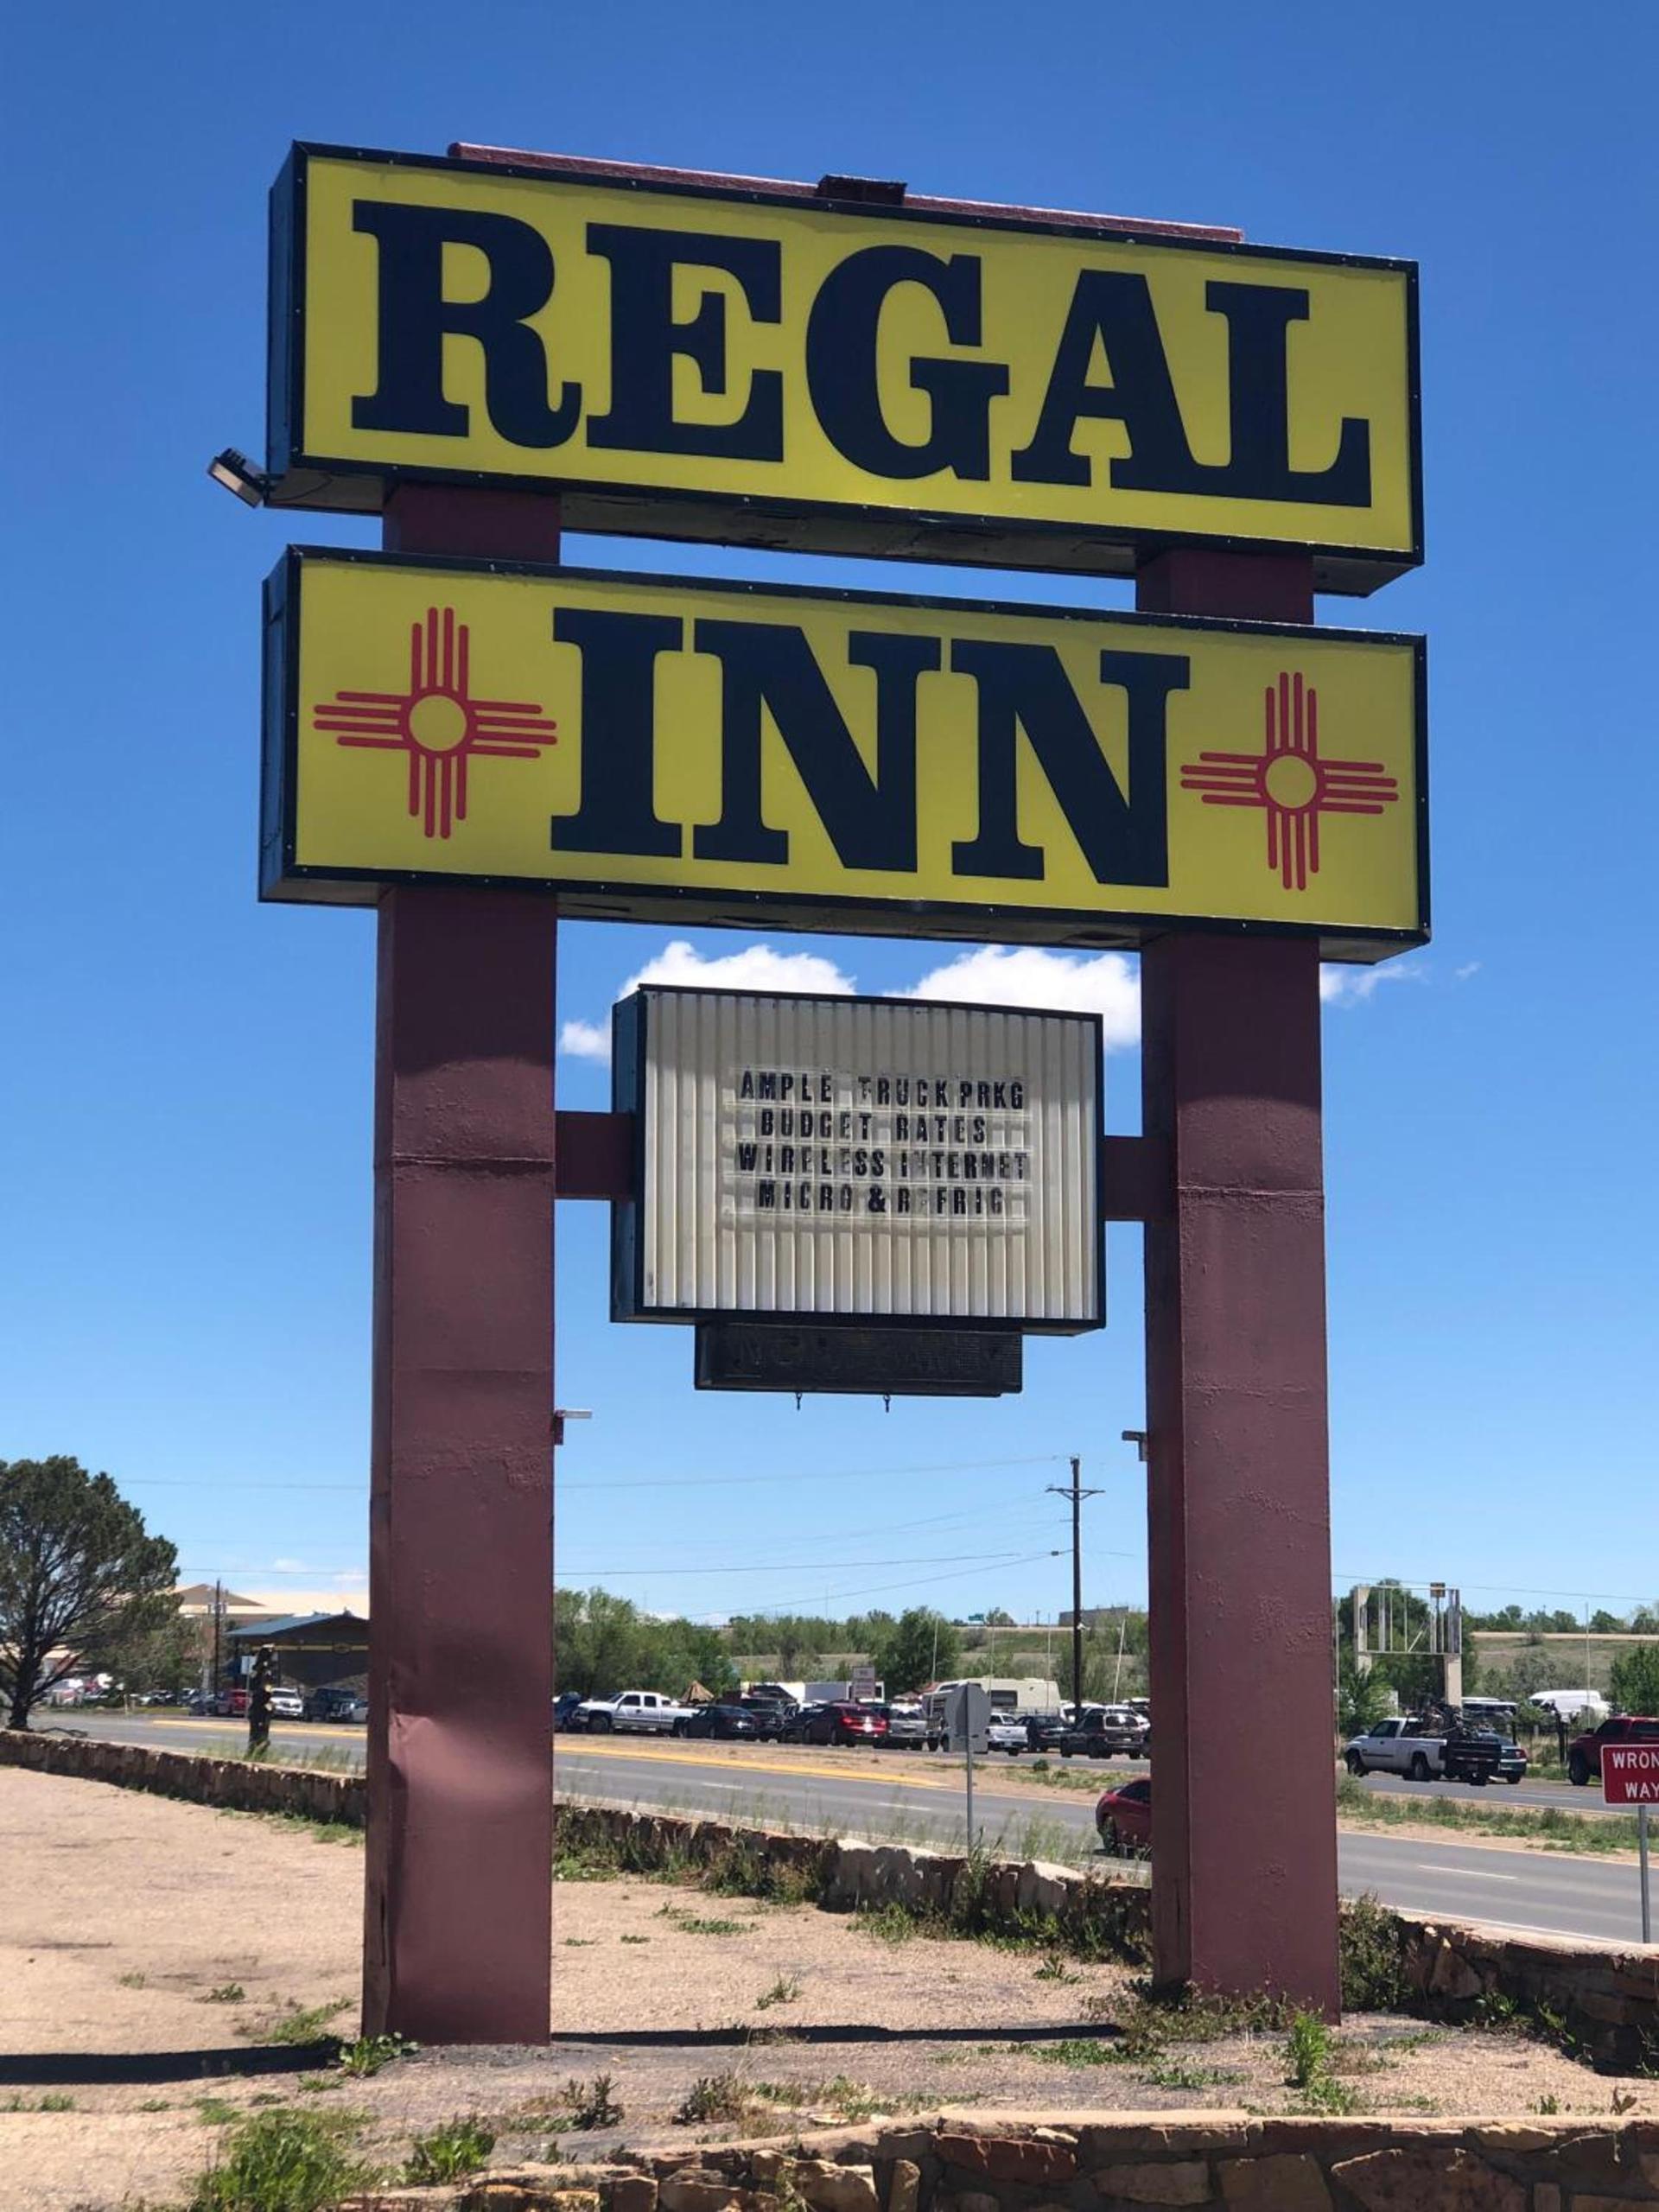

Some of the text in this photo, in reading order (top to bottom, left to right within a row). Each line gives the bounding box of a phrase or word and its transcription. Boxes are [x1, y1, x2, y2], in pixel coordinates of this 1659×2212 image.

[351, 199, 1372, 508] REGAL
[550, 607, 1190, 888] INN
[741, 1070, 1023, 1109] AMPLE TRUCK PRKG
[761, 1109, 986, 1144] BUDGET RATES
[739, 1142, 885, 1177] WIRELESS
[759, 1180, 852, 1211] MICRO
[898, 1186, 1003, 1215] RFRIG
[1624, 1782, 1659, 1798] WAY
